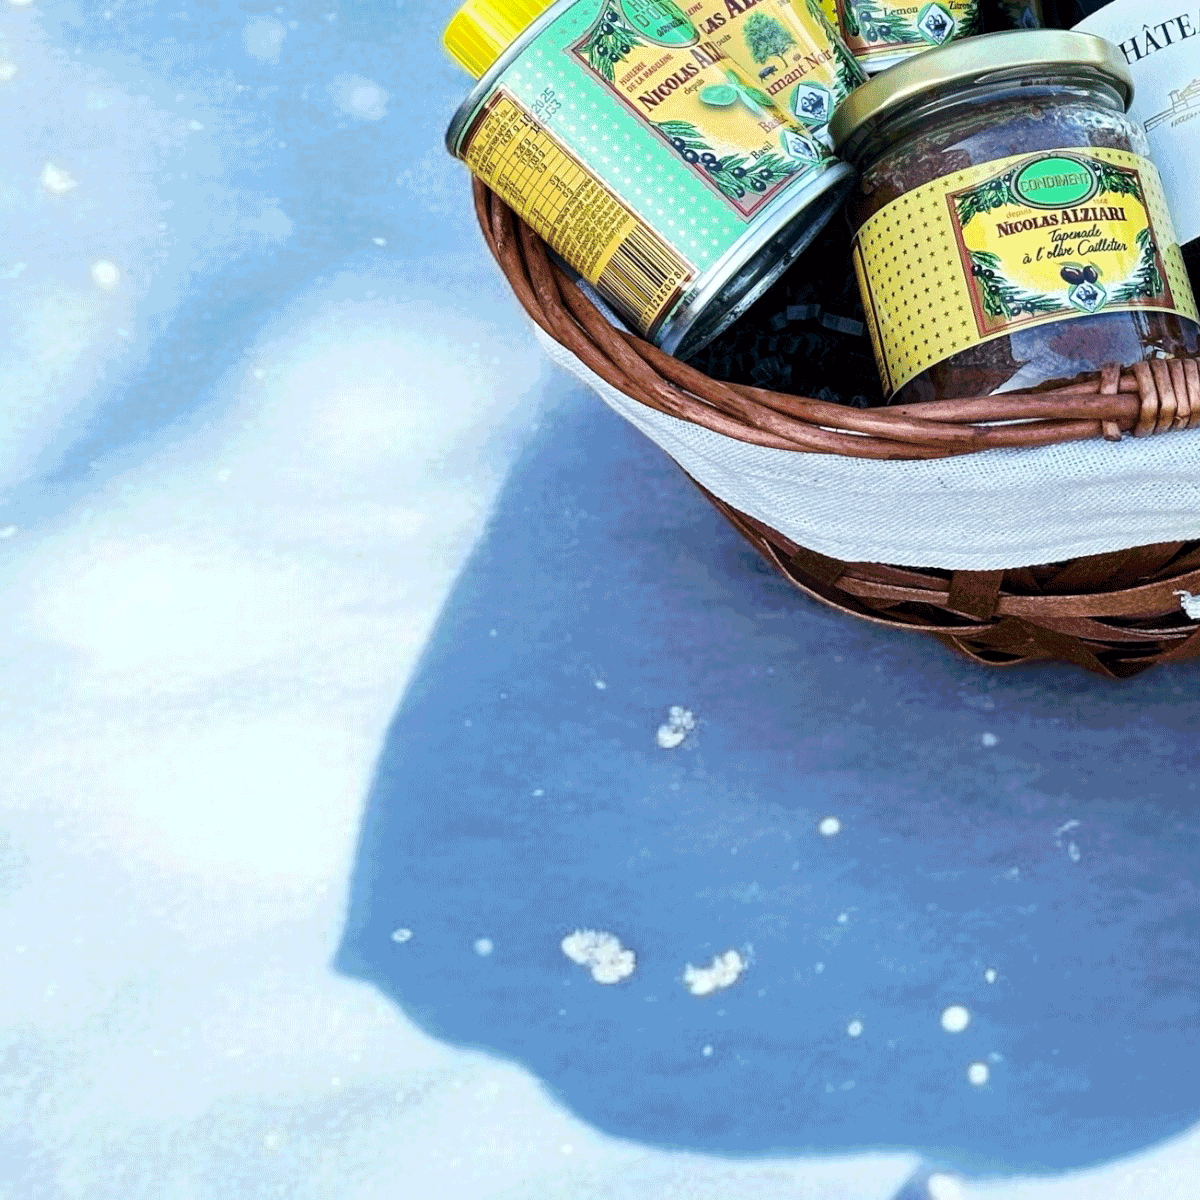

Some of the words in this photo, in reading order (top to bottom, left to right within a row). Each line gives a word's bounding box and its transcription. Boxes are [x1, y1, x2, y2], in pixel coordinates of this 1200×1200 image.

[883, 6, 919, 17] Lemon
[619, 61, 648, 86] HUILERIE
[626, 81, 638, 93] DE
[635, 75, 645, 86] LA
[637, 62, 700, 113] NICOLAS
[750, 140, 774, 161] Basil
[1020, 172, 1089, 193] CONDIMENT
[996, 213, 1059, 239] NICOLAS
[1060, 206, 1127, 225] ALZIARI
[1005, 208, 1033, 219] depuis
[1047, 223, 1102, 247] Tapenade
[1022, 253, 1032, 265] à
[1077, 237, 1128, 256] Cailletier
